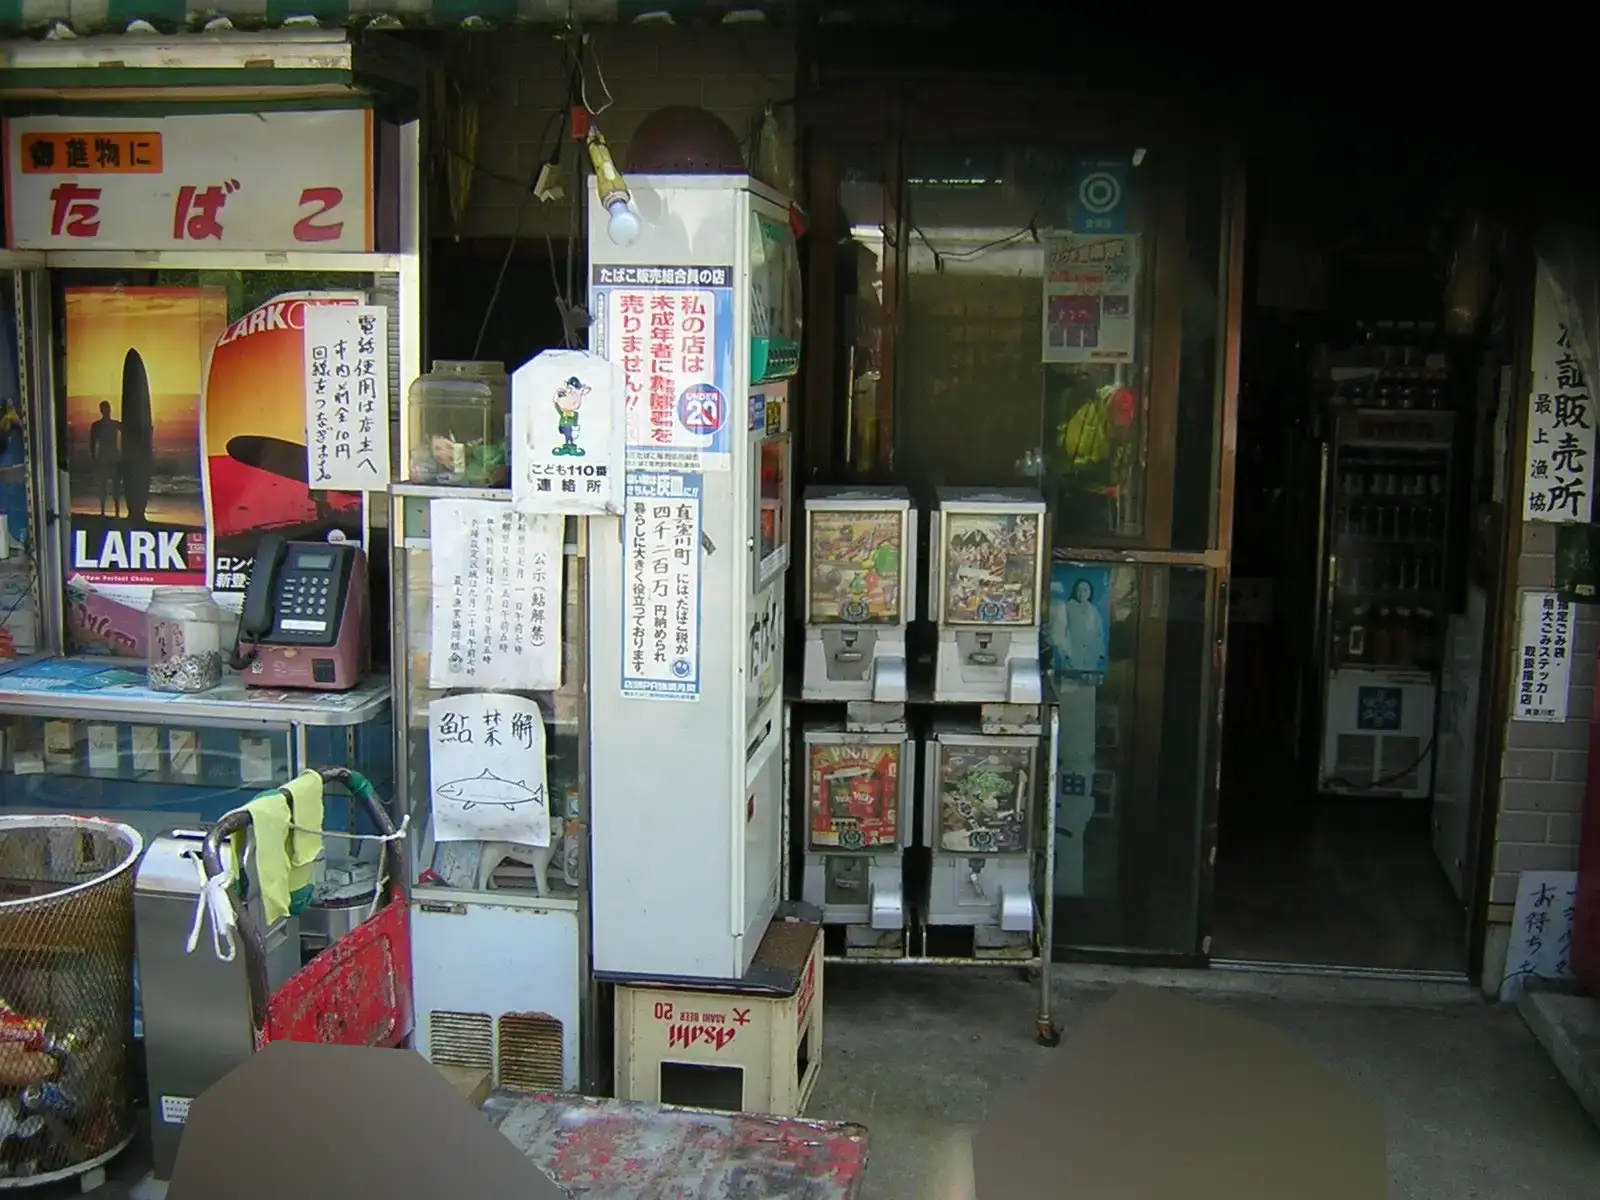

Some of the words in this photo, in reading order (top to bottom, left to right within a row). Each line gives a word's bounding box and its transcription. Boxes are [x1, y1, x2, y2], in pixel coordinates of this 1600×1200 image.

[50, 178, 344, 242] たばこ
[600, 267, 726, 286] たばこ販売組合員の店
[217, 302, 288, 347] LARK
[681, 294, 706, 374] 私の店は
[1528, 393, 1552, 513] 最上漁協
[531, 463, 608, 477] こども110番
[537, 478, 602, 493] 連絡所
[75, 529, 187, 570] LARK
[215, 572, 252, 589] 新登
[654, 1002, 673, 1020] 20
[679, 1011, 700, 1022] BEER
[668, 1023, 736, 1051] Asahi
